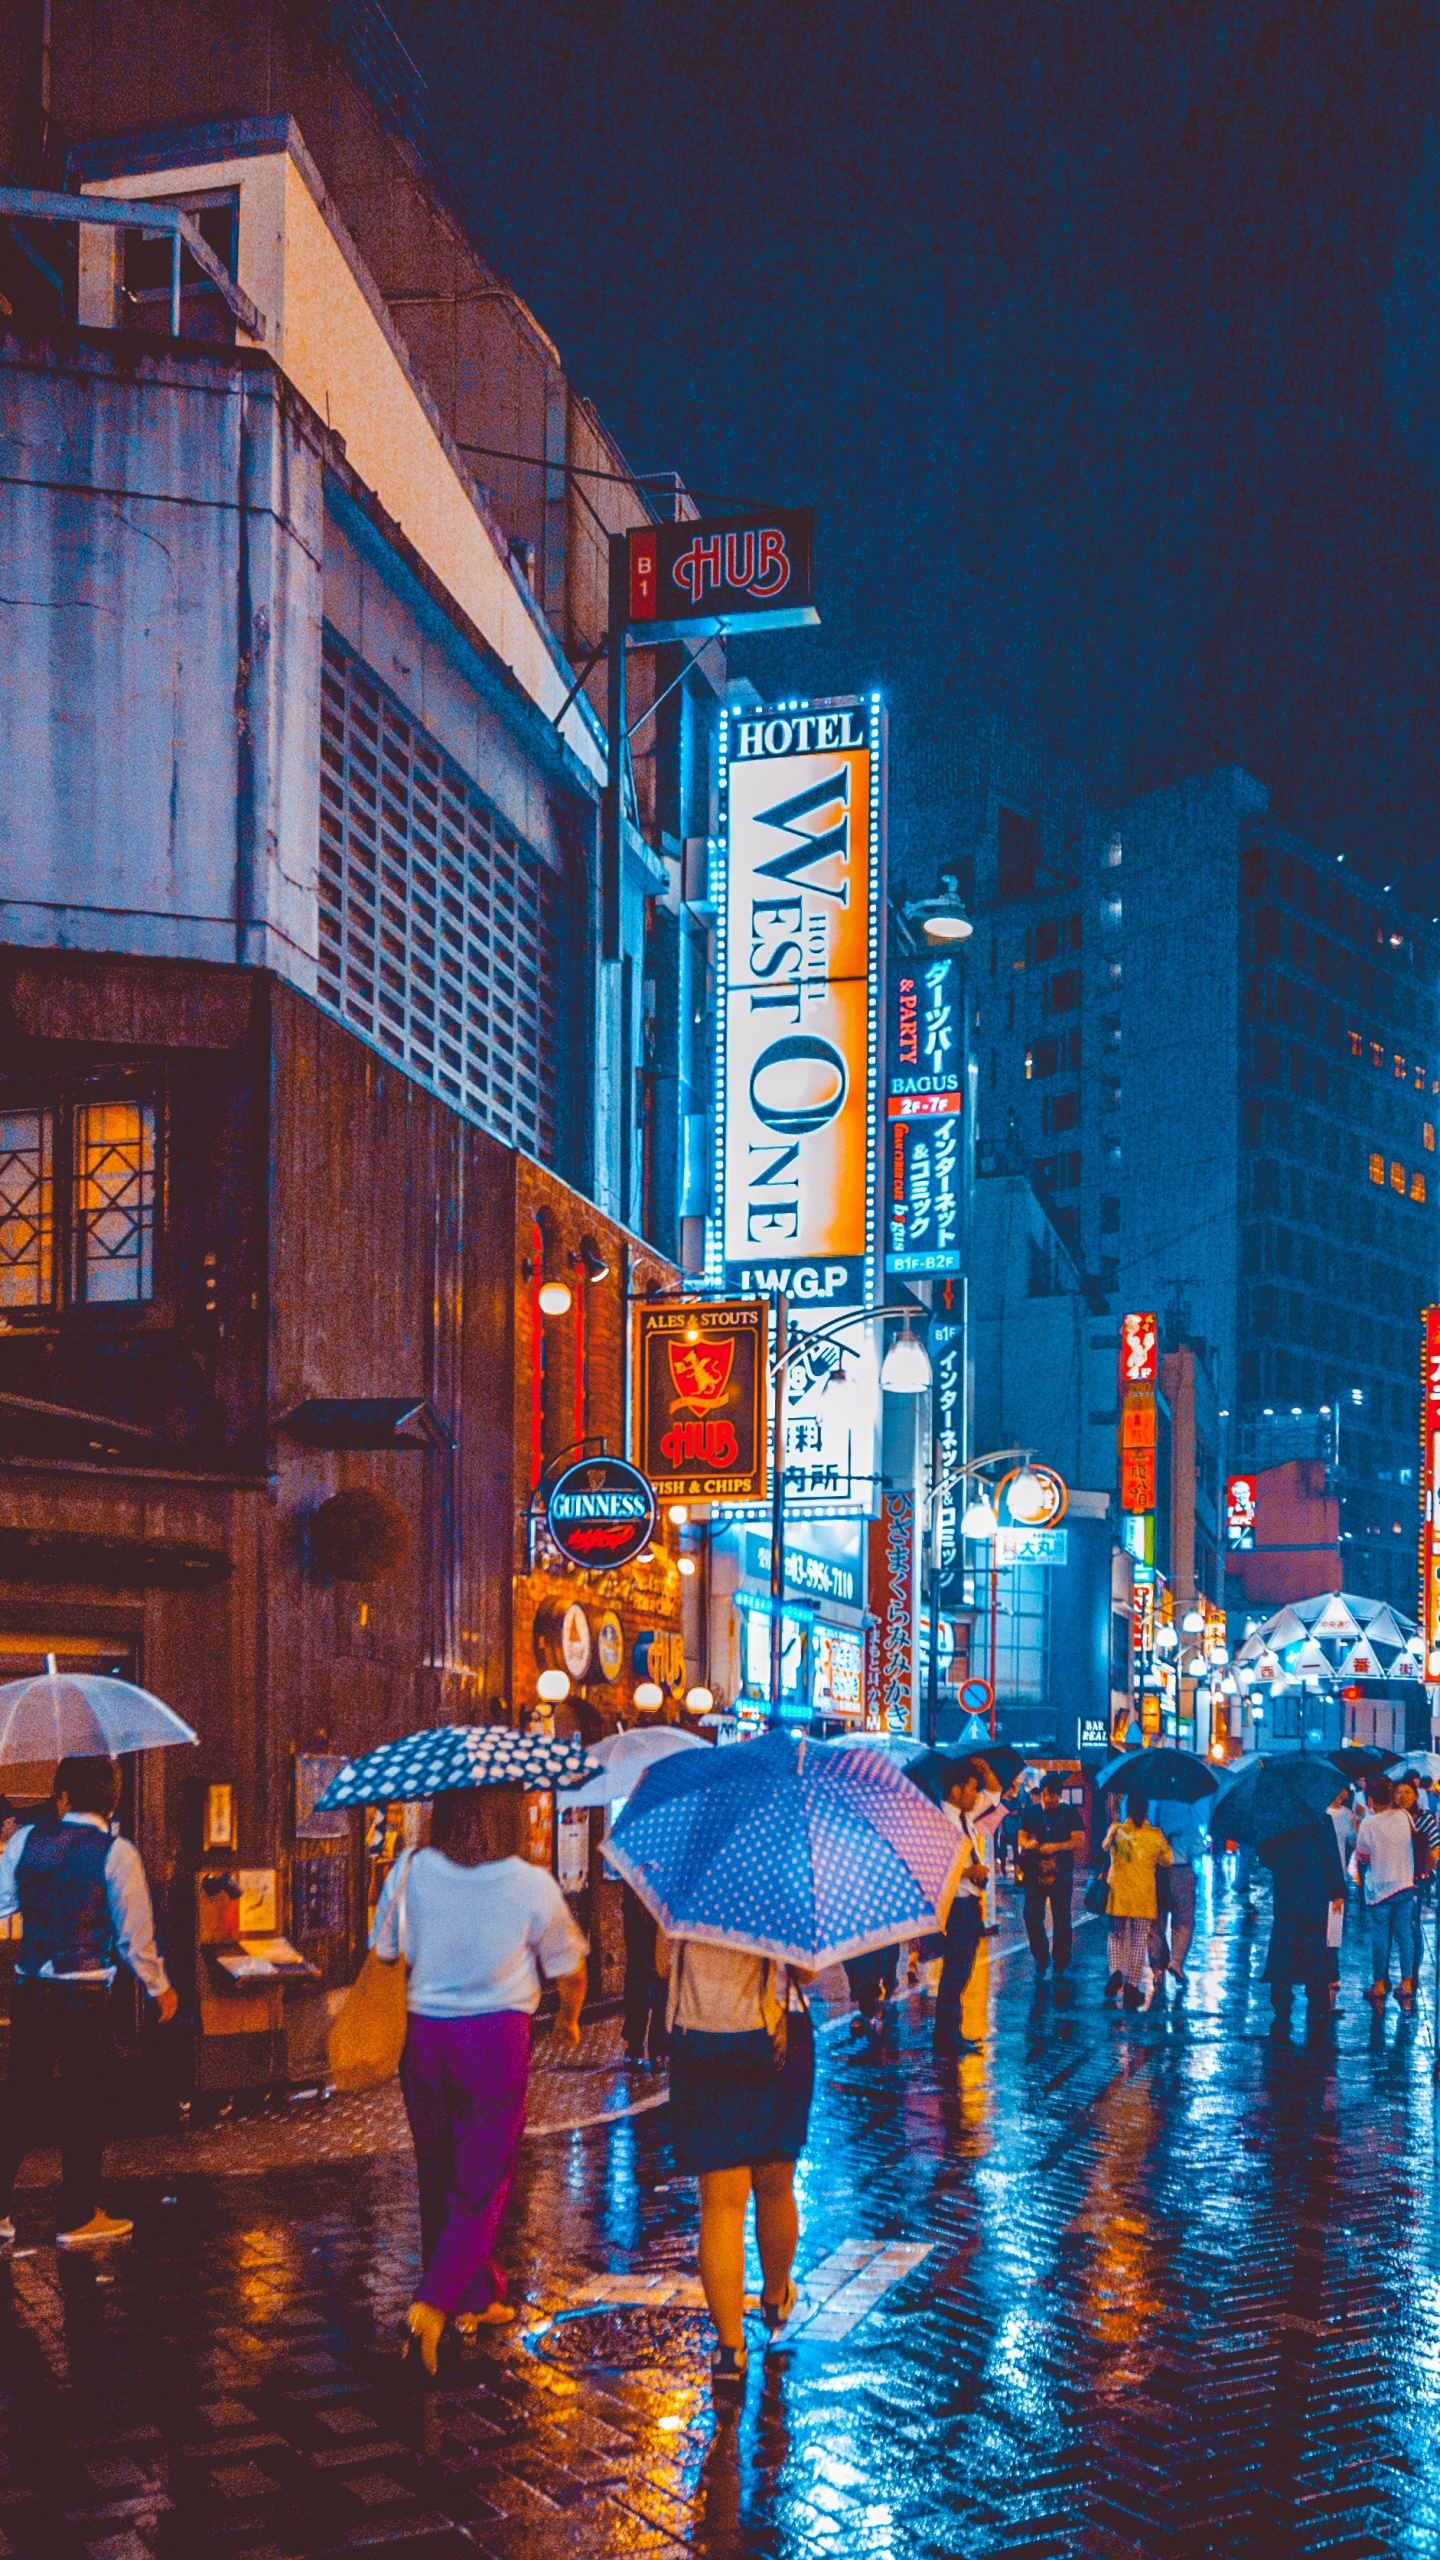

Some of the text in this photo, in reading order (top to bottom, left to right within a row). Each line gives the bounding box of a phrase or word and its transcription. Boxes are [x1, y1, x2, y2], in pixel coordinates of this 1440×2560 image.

[671, 529, 791, 604] HUB
[738, 713, 864, 758] HOTEL
[924, 958, 953, 1074] ダーツバー
[898, 994, 919, 1066] PARTY
[891, 1075, 959, 1095] BAGUS
[900, 1097, 949, 1116] 2F-7F
[934, 1118, 957, 1249] インターネット
[646, 1313, 685, 1330] ALES
[701, 1311, 758, 1327] STOUTS
[935, 1326, 956, 1342] B1F
[660, 1419, 739, 1469] HUB
[689, 1479, 702, 1495] &
[704, 1478, 752, 1494] CHIPS
[553, 1493, 646, 1519] GUINNESS
[1082, 1731, 1108, 1742] REAL
[1085, 1719, 1105, 1731] BAR
